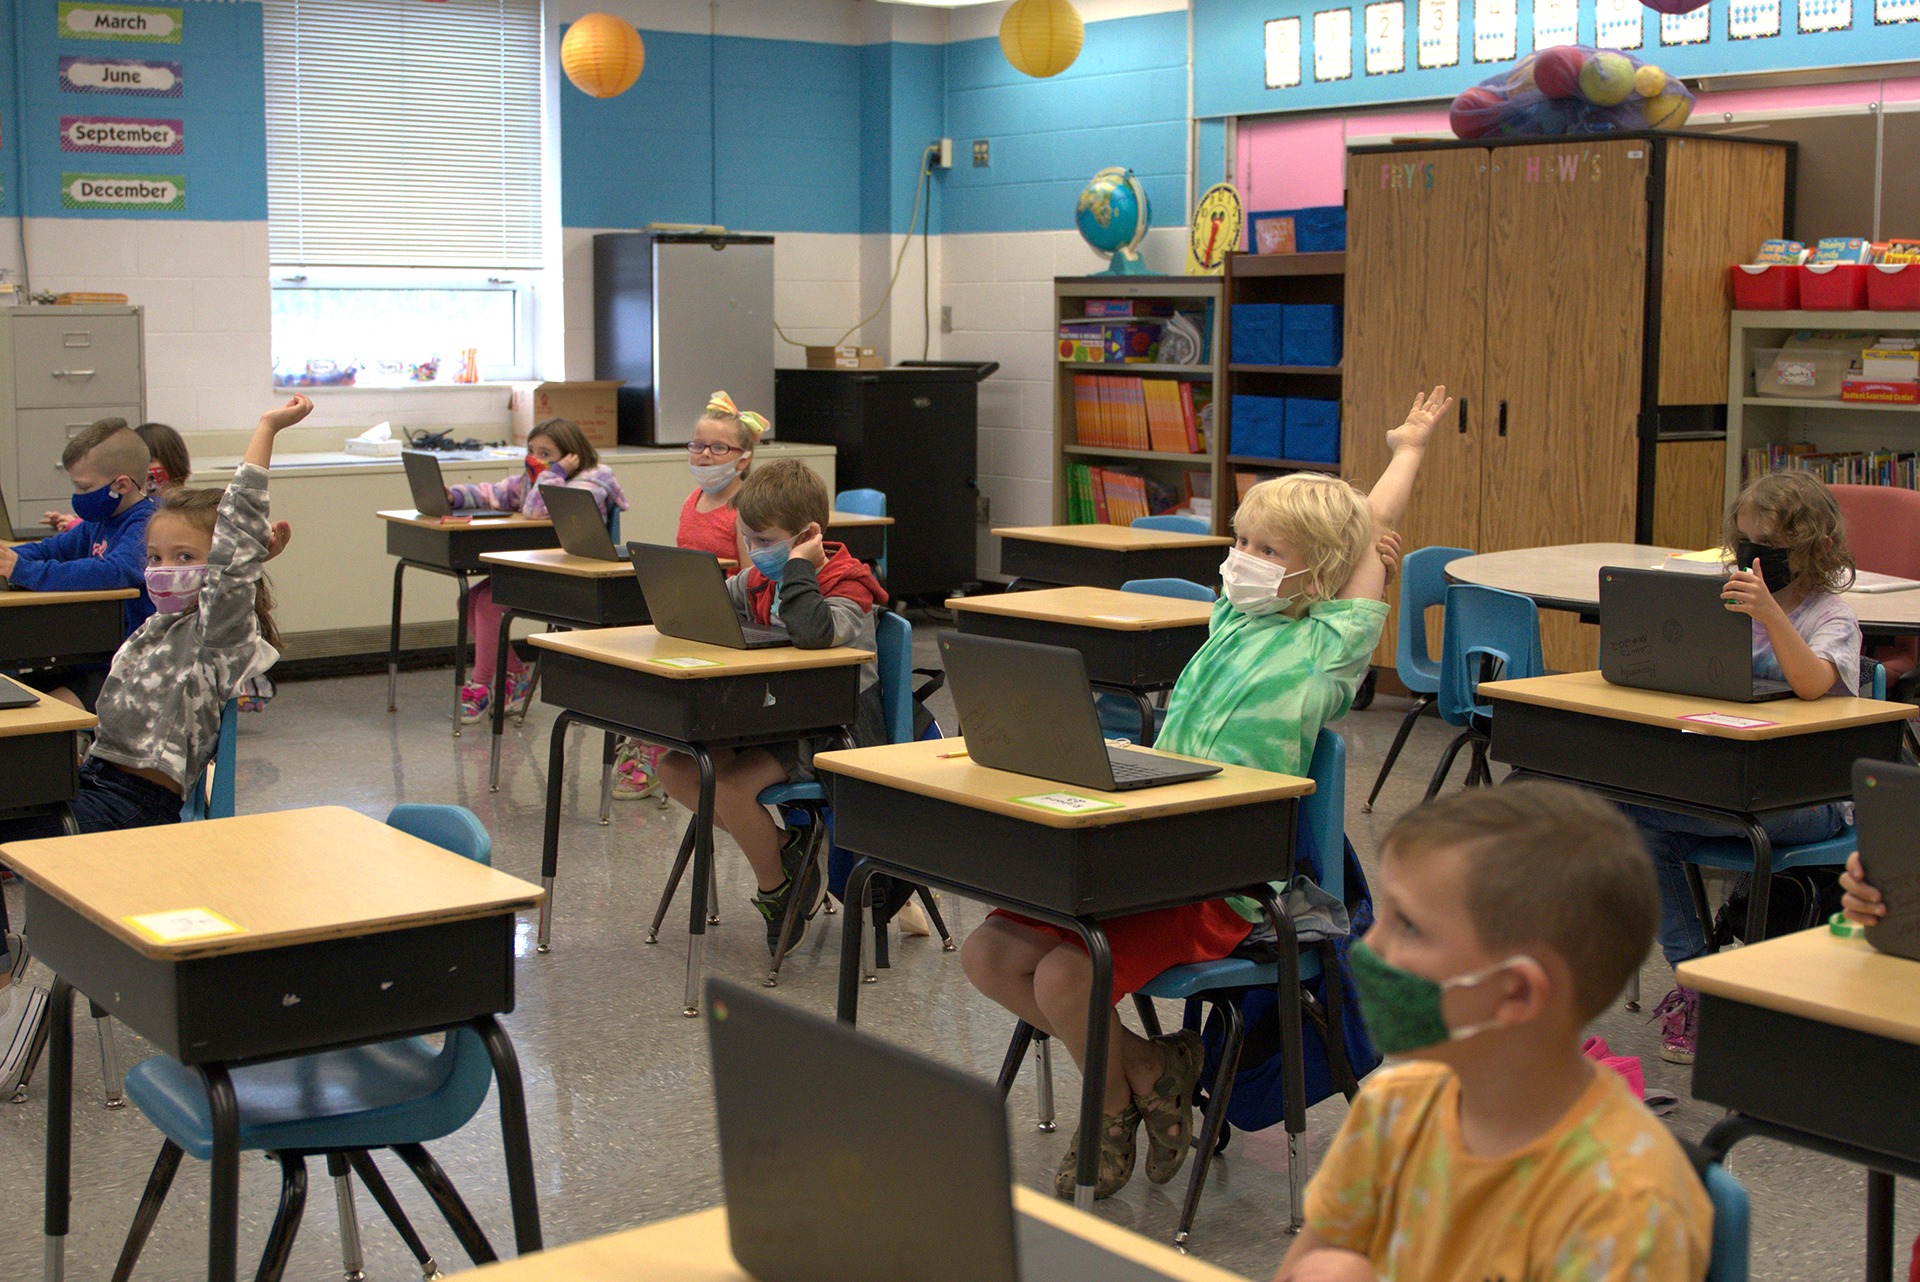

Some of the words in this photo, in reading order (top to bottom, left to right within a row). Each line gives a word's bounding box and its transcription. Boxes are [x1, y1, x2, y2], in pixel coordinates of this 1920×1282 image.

[94, 14, 147, 30] March
[1379, 15, 1390, 39] 2
[1433, 8, 1444, 31] 3
[102, 68, 141, 84] June
[76, 126, 169, 144] September
[81, 183, 167, 198] December
[1866, 391, 1893, 401] Learning
[1894, 392, 1914, 401] Center
